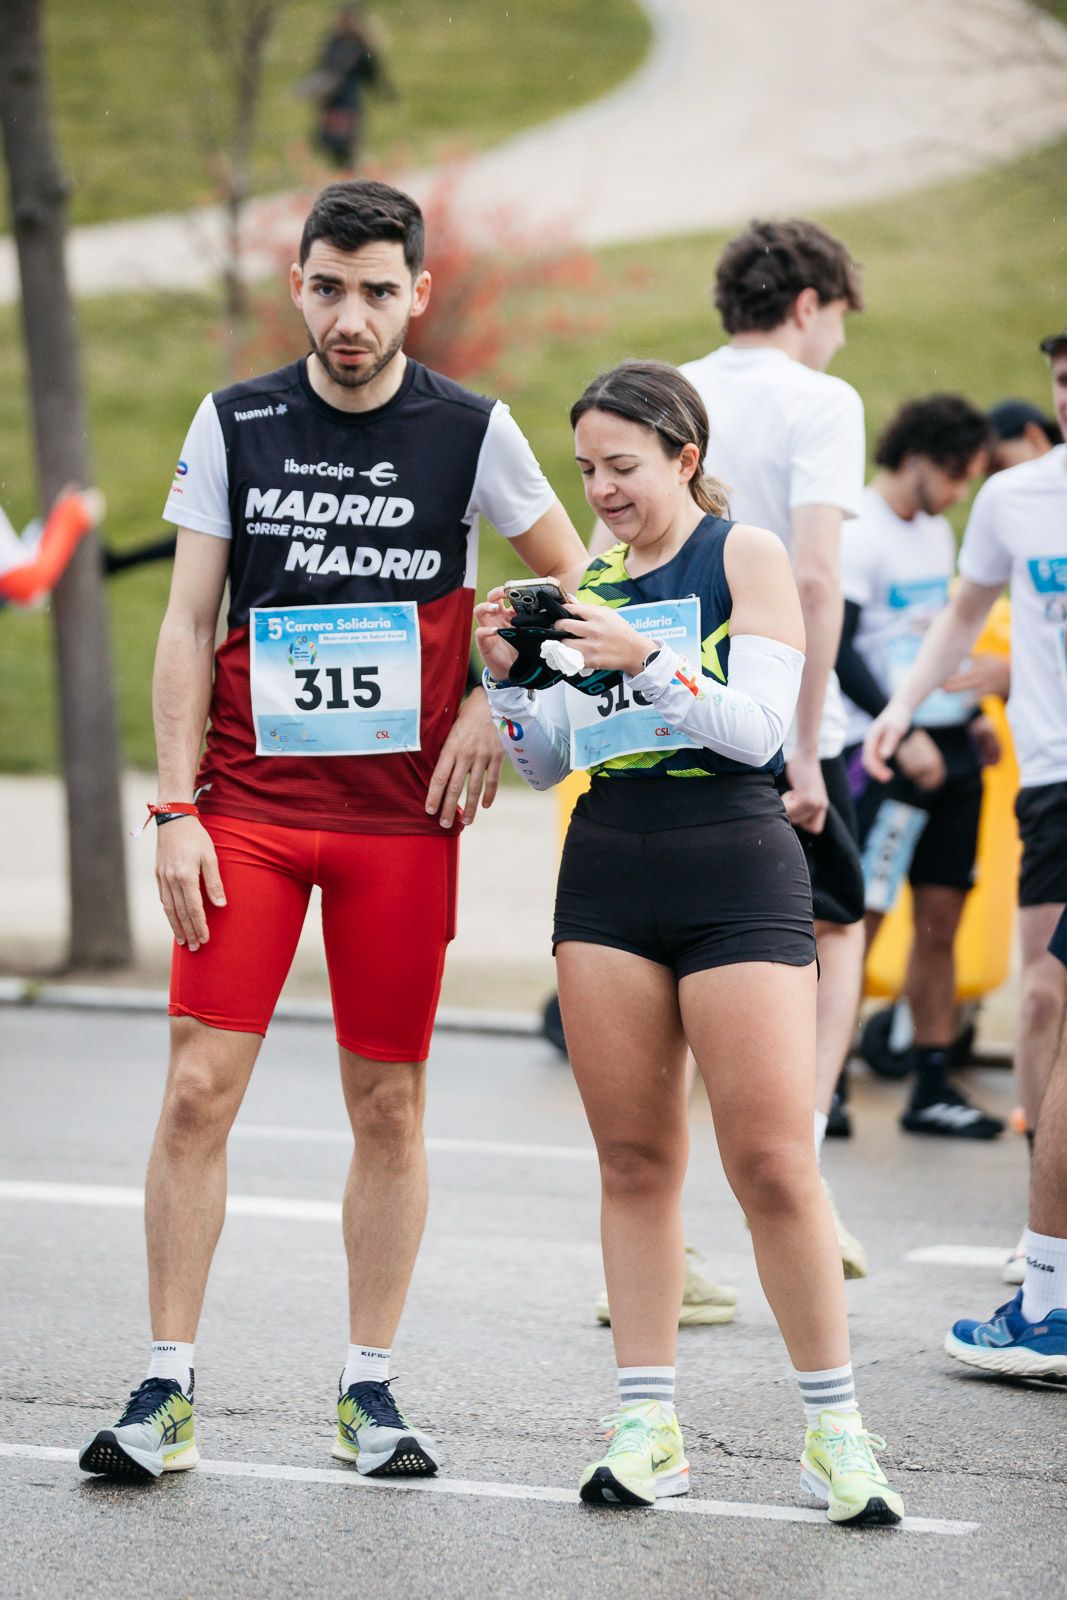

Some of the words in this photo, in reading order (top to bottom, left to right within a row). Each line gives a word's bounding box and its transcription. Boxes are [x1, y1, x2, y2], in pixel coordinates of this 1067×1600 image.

[233, 405, 274, 421] luanvi
[245, 488, 414, 527] MADRID
[246, 523, 291, 537] CORRE
[292, 525, 327, 541] POR
[284, 541, 441, 580] MADRID
[286, 621, 334, 633] Carrera
[336, 616, 392, 630] Solidaria
[627, 615, 673, 630] olidaria
[295, 666, 381, 711] 315
[376, 730, 390, 739] CSL
[655, 727, 671, 736] CSL
